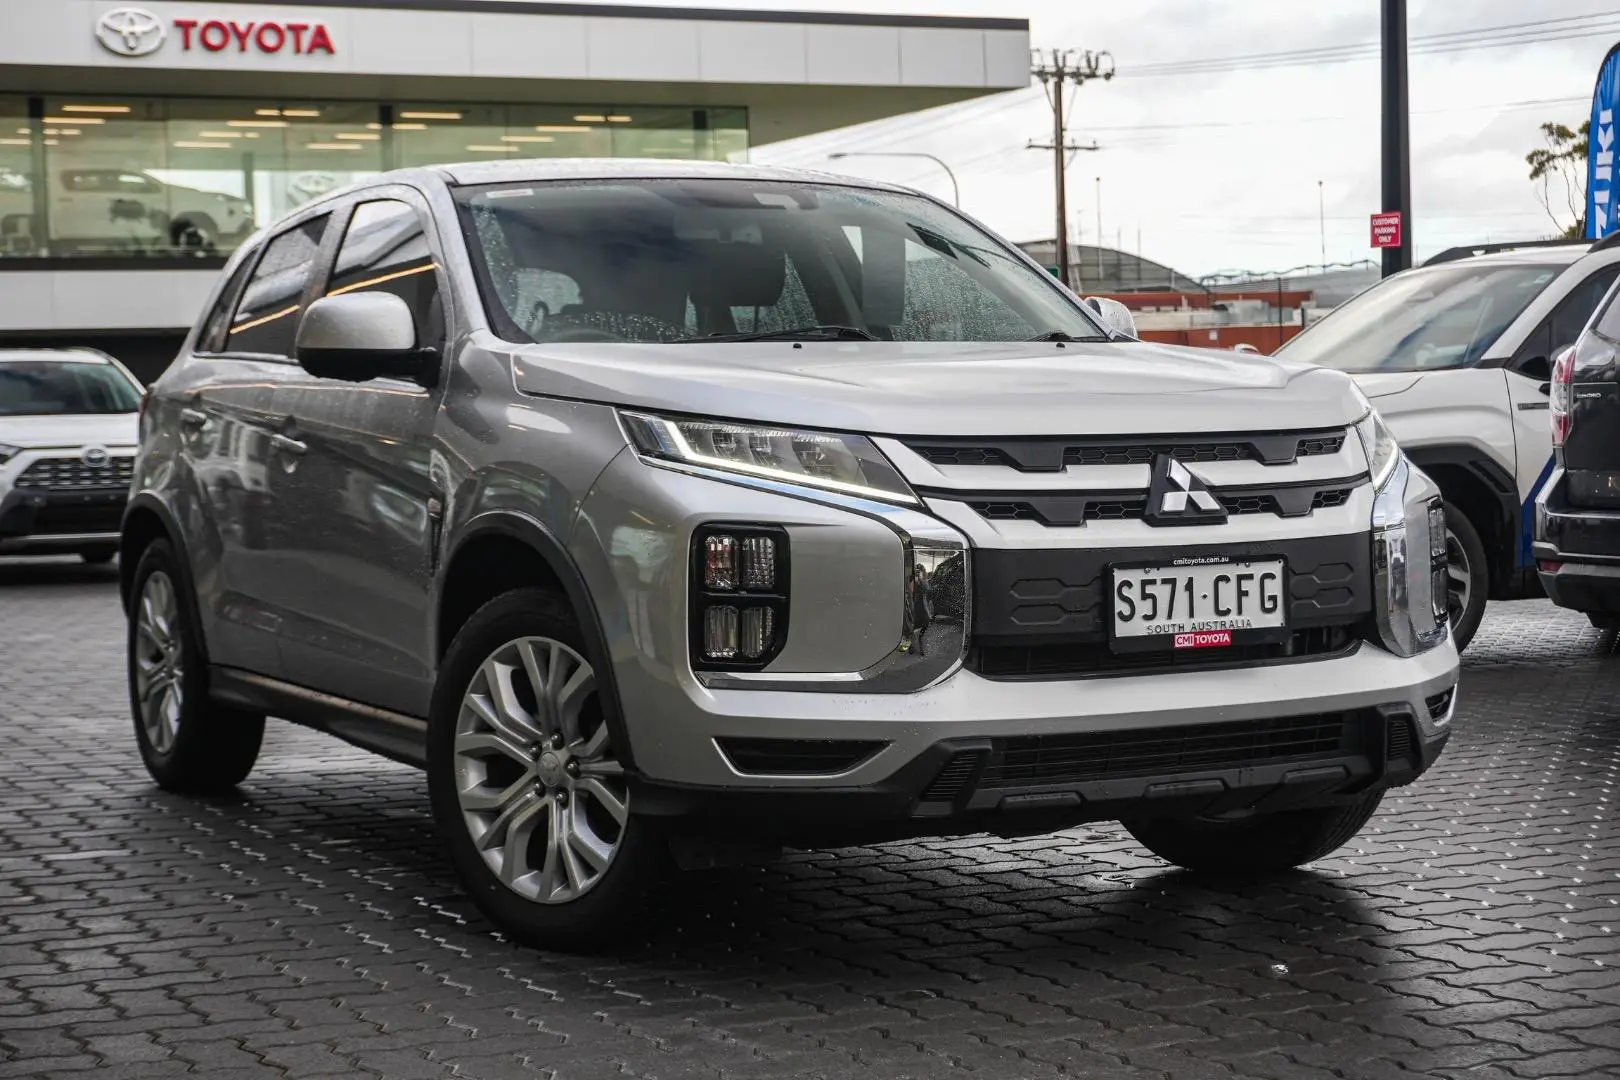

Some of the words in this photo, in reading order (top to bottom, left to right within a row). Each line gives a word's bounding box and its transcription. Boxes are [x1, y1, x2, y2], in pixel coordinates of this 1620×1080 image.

[174, 20, 336, 54] TOYOTA
[1373, 217, 1398, 225] CUSTOMER
[1173, 557, 1229, 565] cmitoyota.com.au
[1147, 623, 1185, 634] SOUTH
[1191, 619, 1252, 632] AUSTRALIA
[1176, 635, 1193, 645] CMI
[1195, 634, 1230, 644] TOYOTA
